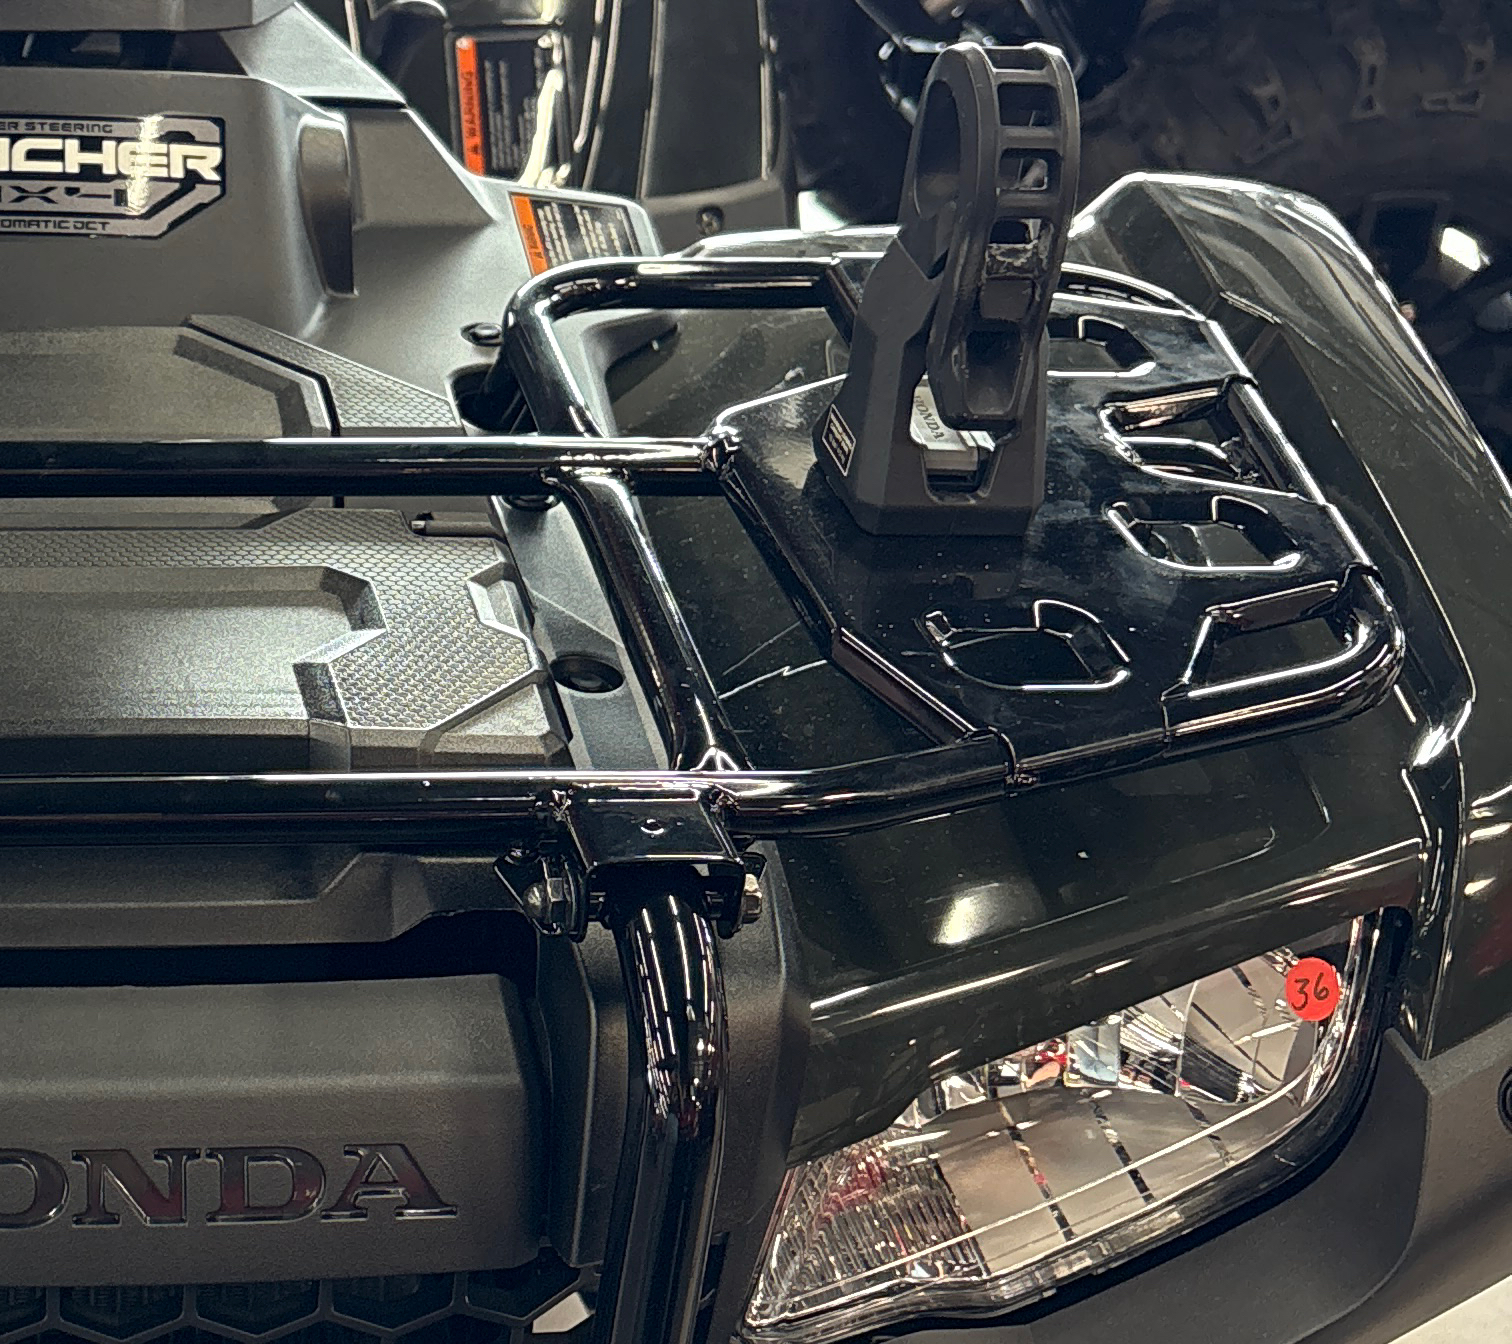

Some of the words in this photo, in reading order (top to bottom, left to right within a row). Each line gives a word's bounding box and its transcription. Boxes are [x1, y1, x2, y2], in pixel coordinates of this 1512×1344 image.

[24, 121, 113, 134] STEERING
[72, 219, 110, 232] DCT
[914, 395, 945, 439] HONDA
[1291, 972, 1330, 1011] 36
